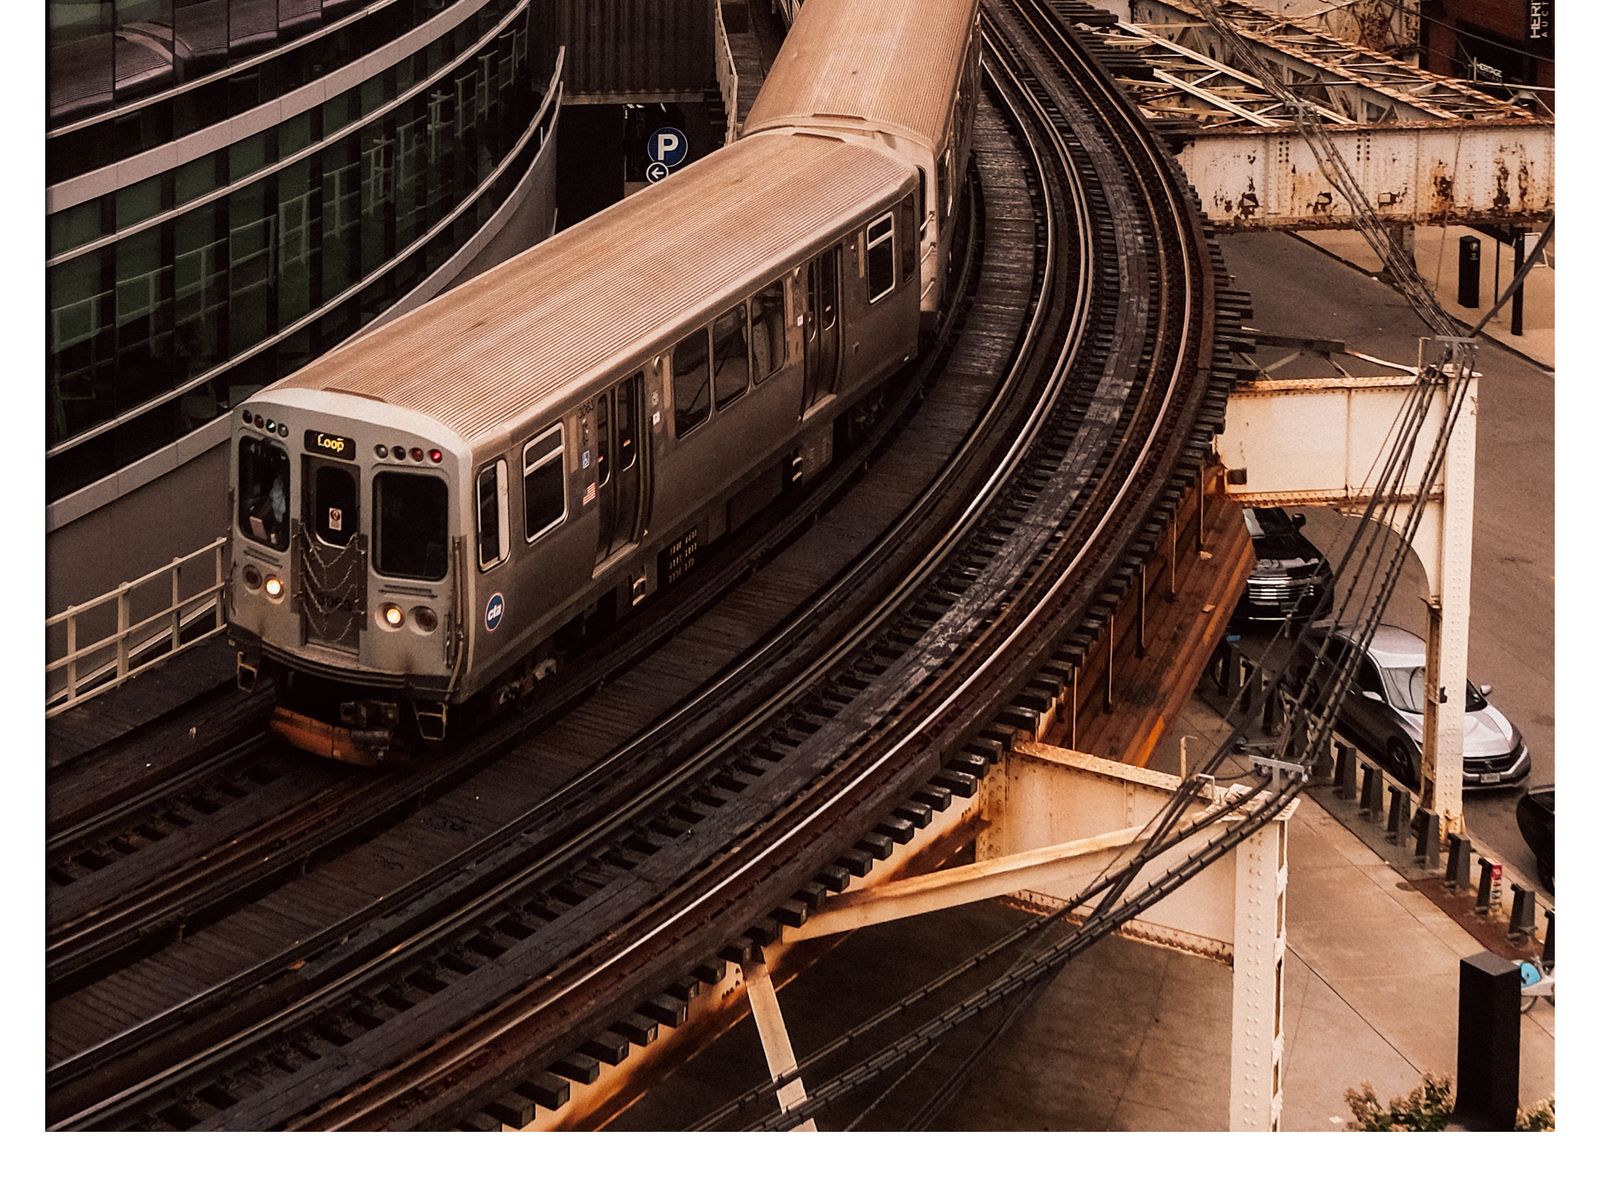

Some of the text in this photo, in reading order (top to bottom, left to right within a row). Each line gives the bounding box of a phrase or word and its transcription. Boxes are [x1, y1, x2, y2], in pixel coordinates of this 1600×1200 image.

[658, 133, 679, 160] P
[317, 434, 345, 453] Loop
[487, 604, 502, 621] cta
